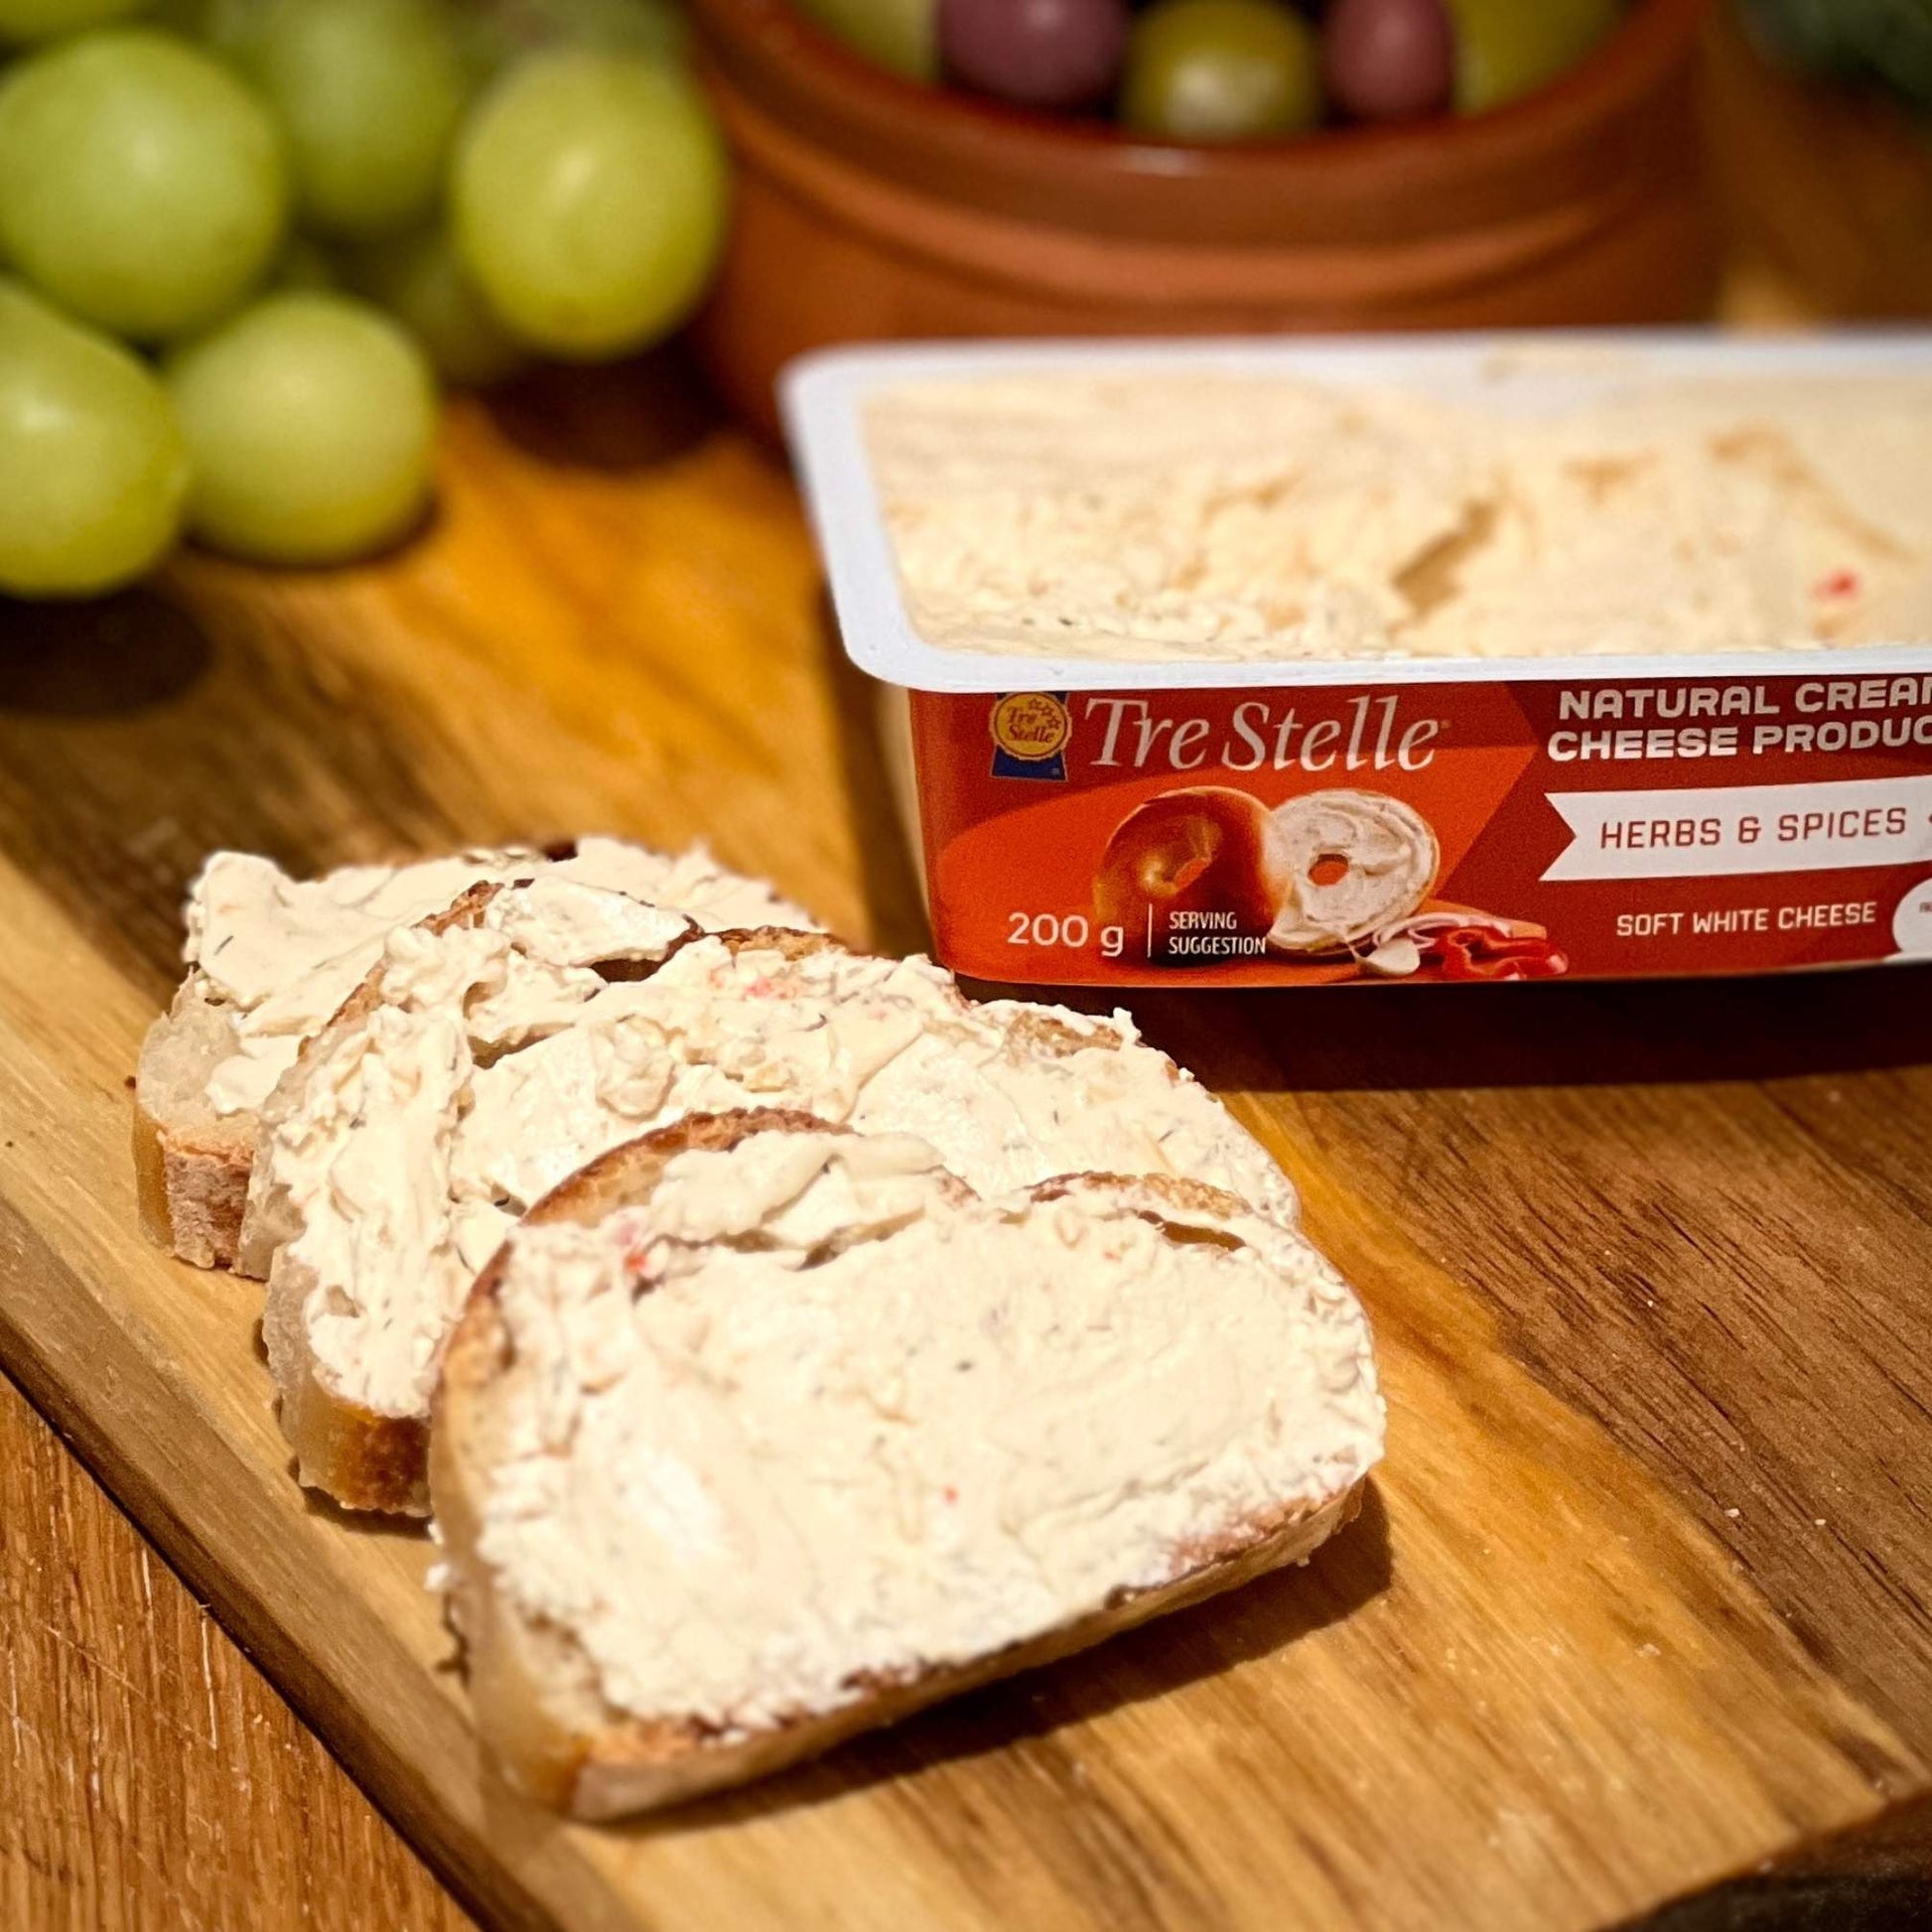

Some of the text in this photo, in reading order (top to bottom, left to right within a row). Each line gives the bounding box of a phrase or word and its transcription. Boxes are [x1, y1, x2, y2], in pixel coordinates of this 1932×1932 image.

[1009, 707, 1037, 724] Tre
[1560, 685, 1780, 720] NATURAL
[1009, 724, 1055, 743] Stelle
[1085, 694, 1440, 771] Tre Stelle
[1547, 727, 1738, 761] CHEESE
[1600, 807, 1907, 849] HERBS & SPICES
[1008, 912, 1125, 956] 200 g
[1169, 910, 1237, 930] SERVING
[1616, 901, 1877, 936] SOFT WHITE CHEESE
[1169, 934, 1266, 955] SUGGESTION
